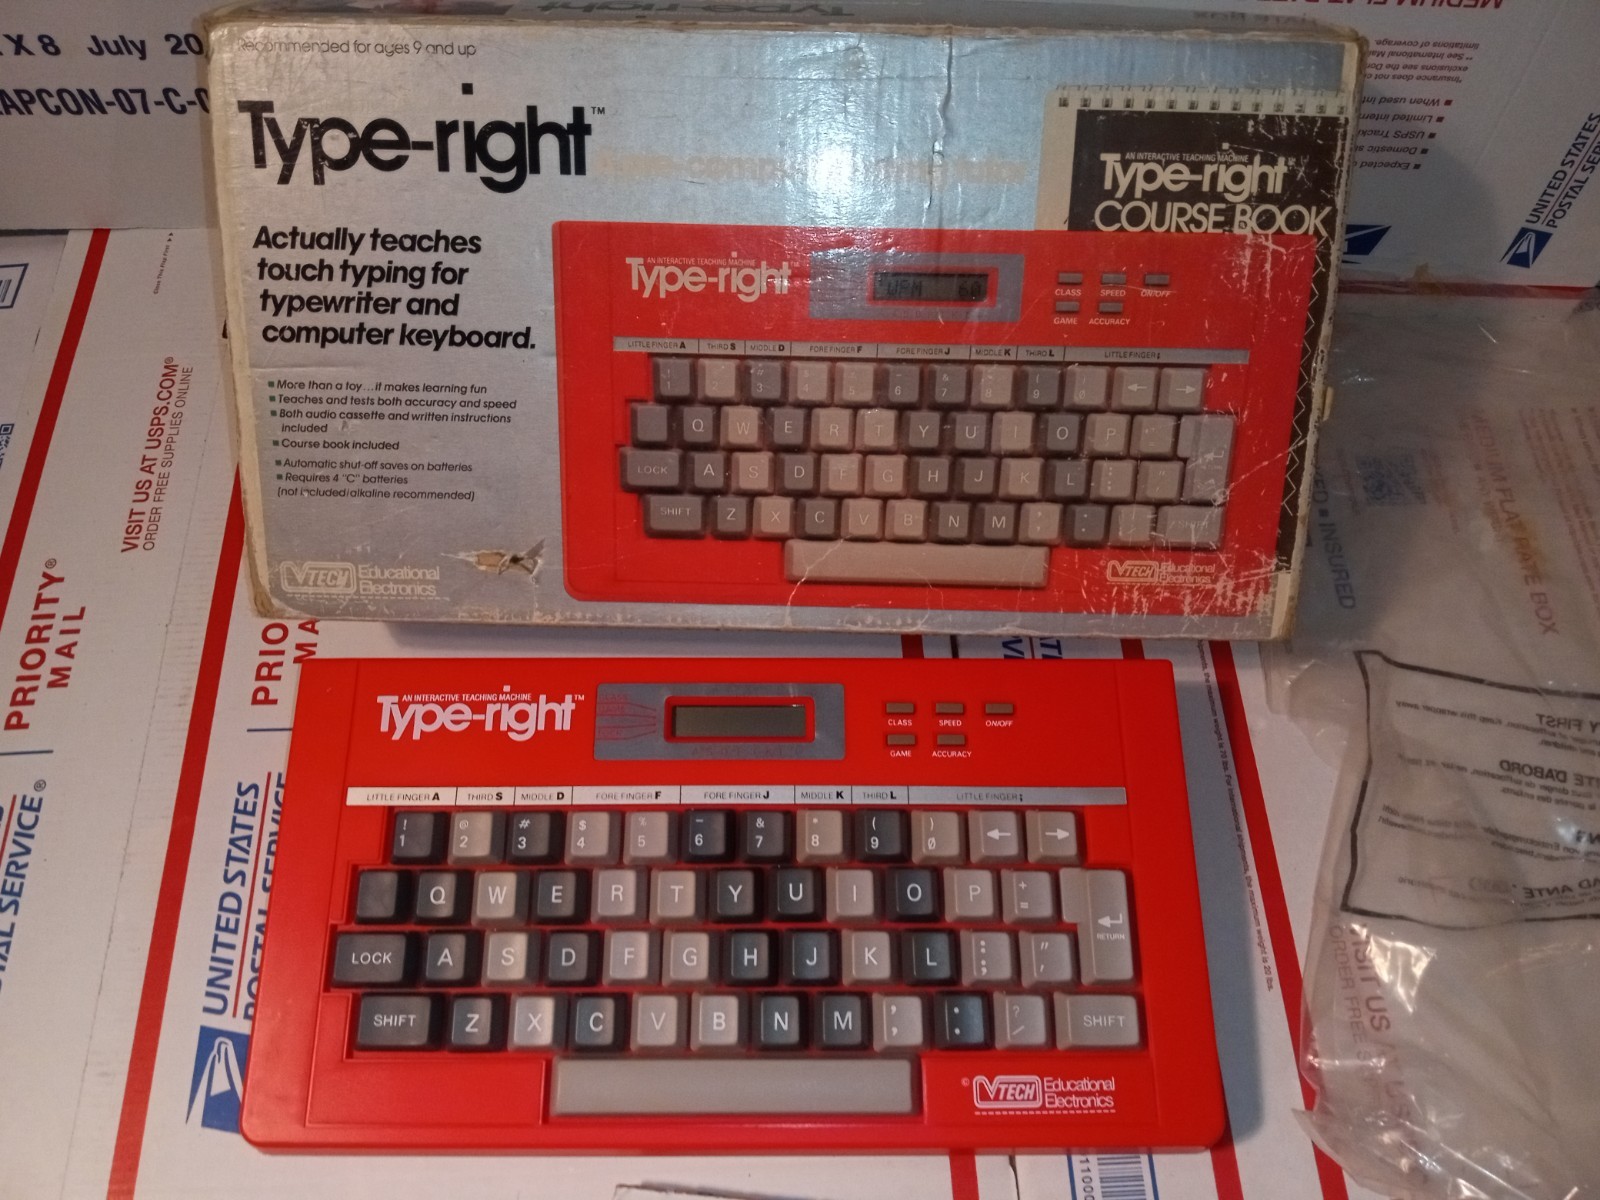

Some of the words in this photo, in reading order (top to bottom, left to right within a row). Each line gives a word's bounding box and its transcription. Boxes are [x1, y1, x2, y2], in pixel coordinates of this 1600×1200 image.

[3, 34, 35, 56] X
[37, 34, 61, 56] 8
[87, 34, 147, 61] July
[237, 39, 350, 53] Recommended
[353, 40, 372, 53] for
[374, 43, 410, 57] ages
[413, 40, 422, 54] 9
[425, 41, 454, 55] and
[457, 45, 477, 58] up
[1374, 39, 1419, 48] coverage.
[1420, 40, 1430, 48] of
[1433, 42, 1480, 50] limitations
[1388, 51, 1445, 59] International
[1410, 98, 1440, 106] When
[1392, 114, 1432, 123] Limited
[237, 82, 592, 193] Type-right
[1393, 131, 1425, 139] USPS
[1125, 151, 1135, 160] AN
[1136, 152, 1180, 161] INTERACTIVE
[1182, 152, 1216, 162] TEACHING
[1217, 153, 1249, 163] MACHINE
[1367, 146, 1417, 154] Domestic
[1360, 161, 1410, 169] Expected
[1525, 169, 1567, 224] UNITED
[1561, 113, 1600, 168] STATES
[1101, 142, 1288, 203] Type-right
[1546, 177, 1589, 228] POSTAL
[1094, 200, 1227, 233] COURSE
[1233, 203, 1332, 238] BOOK
[252, 226, 366, 255] Actually
[369, 228, 482, 254] teaches
[656, 257, 695, 265] INTERACTIVE
[697, 258, 727, 266] TEACHING
[728, 259, 756, 267] MACHINE
[257, 258, 334, 282] touch
[340, 260, 426, 288] typing
[431, 261, 469, 285] for
[626, 251, 791, 302] Type-right
[1054, 288, 1082, 297] CLASS
[1100, 289, 1126, 297] SPEED
[260, 288, 402, 317] typewriter
[406, 293, 459, 316] and
[1053, 317, 1078, 325] GAME
[1088, 317, 1130, 326] ACCURACY
[261, 322, 393, 348] computer
[399, 323, 536, 351] keyboard.
[174, 366, 194, 408] ONLINE
[277, 380, 305, 390] More
[308, 380, 333, 391] than
[335, 383, 343, 391] a
[385, 382, 420, 393] makes
[422, 383, 467, 395] learning
[470, 384, 487, 394] fun
[278, 394, 323, 406] Teaches
[325, 395, 348, 406] and
[350, 395, 375, 406] tests
[377, 396, 402, 407] both
[404, 398, 457, 409] accuracy
[459, 398, 481, 408] and
[483, 399, 517, 410] speed
[279, 408, 303, 420] Both
[305, 409, 337, 420] audio
[339, 410, 385, 421] cassette
[388, 411, 409, 421] and
[411, 412, 449, 422] written
[450, 412, 512, 423] instructions
[281, 423, 328, 433] included
[161, 411, 184, 468] SUPPLIES
[281, 439, 320, 449] Course
[322, 439, 350, 450] book
[352, 440, 400, 450] included
[140, 454, 158, 474] AT
[283, 458, 337, 470] Automatic
[339, 459, 378, 470] shut-off
[380, 462, 409, 471] saves
[427, 461, 473, 472] batteries
[637, 466, 668, 474] LOCK
[285, 472, 330, 484] Requires
[332, 473, 339, 482] 4
[362, 474, 408, 484] batteries
[132, 481, 150, 503] US
[154, 471, 170, 502] FREE
[277, 487, 298, 498] (not
[393, 490, 475, 502] recommended)
[660, 507, 691, 516] SHIFT
[121, 509, 144, 552] VISIT
[143, 506, 162, 551] ORDER
[280, 562, 355, 592] VTECH
[358, 564, 440, 581] Educational
[359, 581, 436, 596] Electronics
[47, 606, 86, 689] MAIL
[414, 694, 460, 702] INTERACTIVE
[462, 693, 497, 701] TEACHING
[499, 693, 531, 701] MACHINE
[377, 685, 576, 741] Type-right
[888, 719, 913, 727] CLASS
[939, 719, 962, 727] SPEED
[890, 750, 911, 758] GAME
[932, 750, 972, 758] ACCURACY
[467, 793, 494, 801] THIRD
[521, 793, 554, 801] MIDDLE
[620, 793, 652, 801] FINGER
[728, 792, 762, 800] FINGER
[801, 792, 833, 800] MIDDLE
[862, 792, 888, 800] THIRD
[203, 890, 242, 1016] UNITED
[223, 781, 259, 887] STATES
[352, 952, 392, 965] LOCK
[373, 1014, 417, 1027] SHIFT
[1083, 1015, 1125, 1028] SHIFT
[1044, 1077, 1115, 1091] Educational
[973, 1075, 1042, 1108] VTECH
[1045, 1093, 1114, 1109] Electronics
